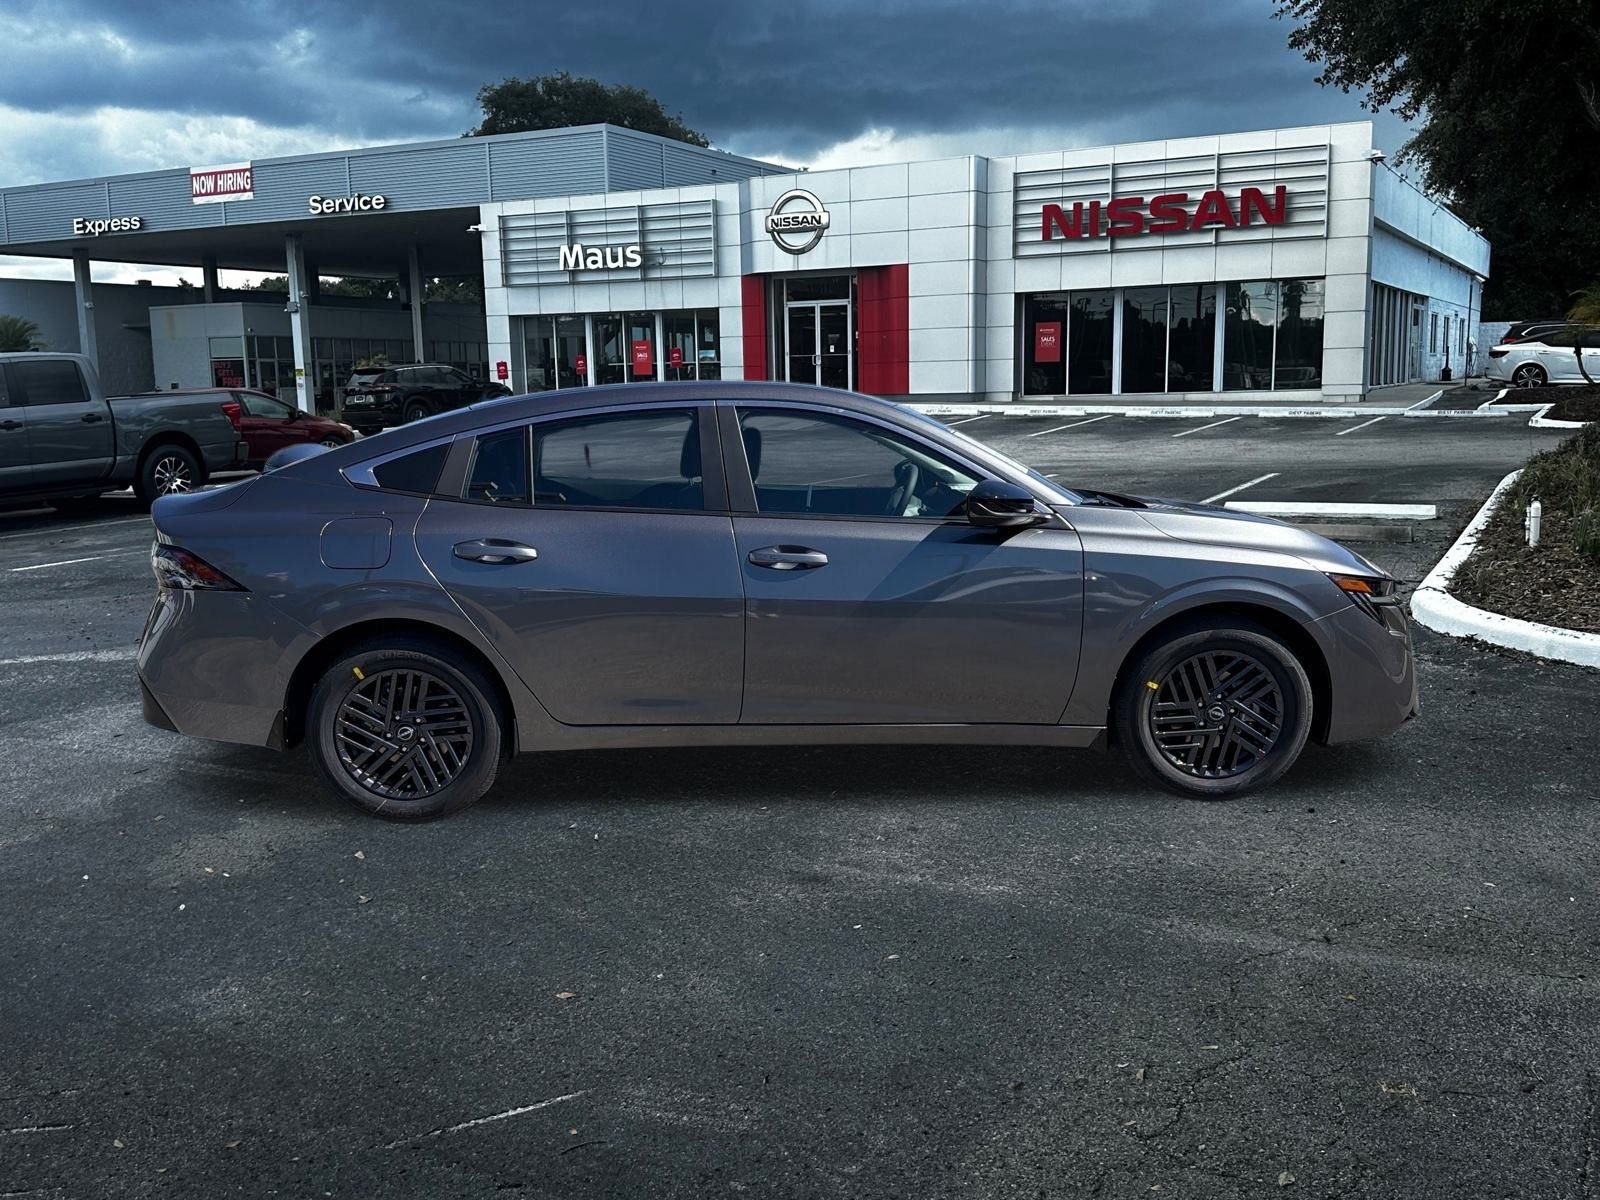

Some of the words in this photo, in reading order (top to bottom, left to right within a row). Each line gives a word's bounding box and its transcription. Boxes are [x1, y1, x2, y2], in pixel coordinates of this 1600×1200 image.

[192, 174, 216, 195] NOW
[217, 171, 251, 192] HIRING
[308, 192, 385, 215] Service
[1042, 189, 1287, 241] NISSAN
[73, 216, 141, 237] Express
[770, 214, 822, 228] NISSAN
[559, 243, 642, 271] Maus
